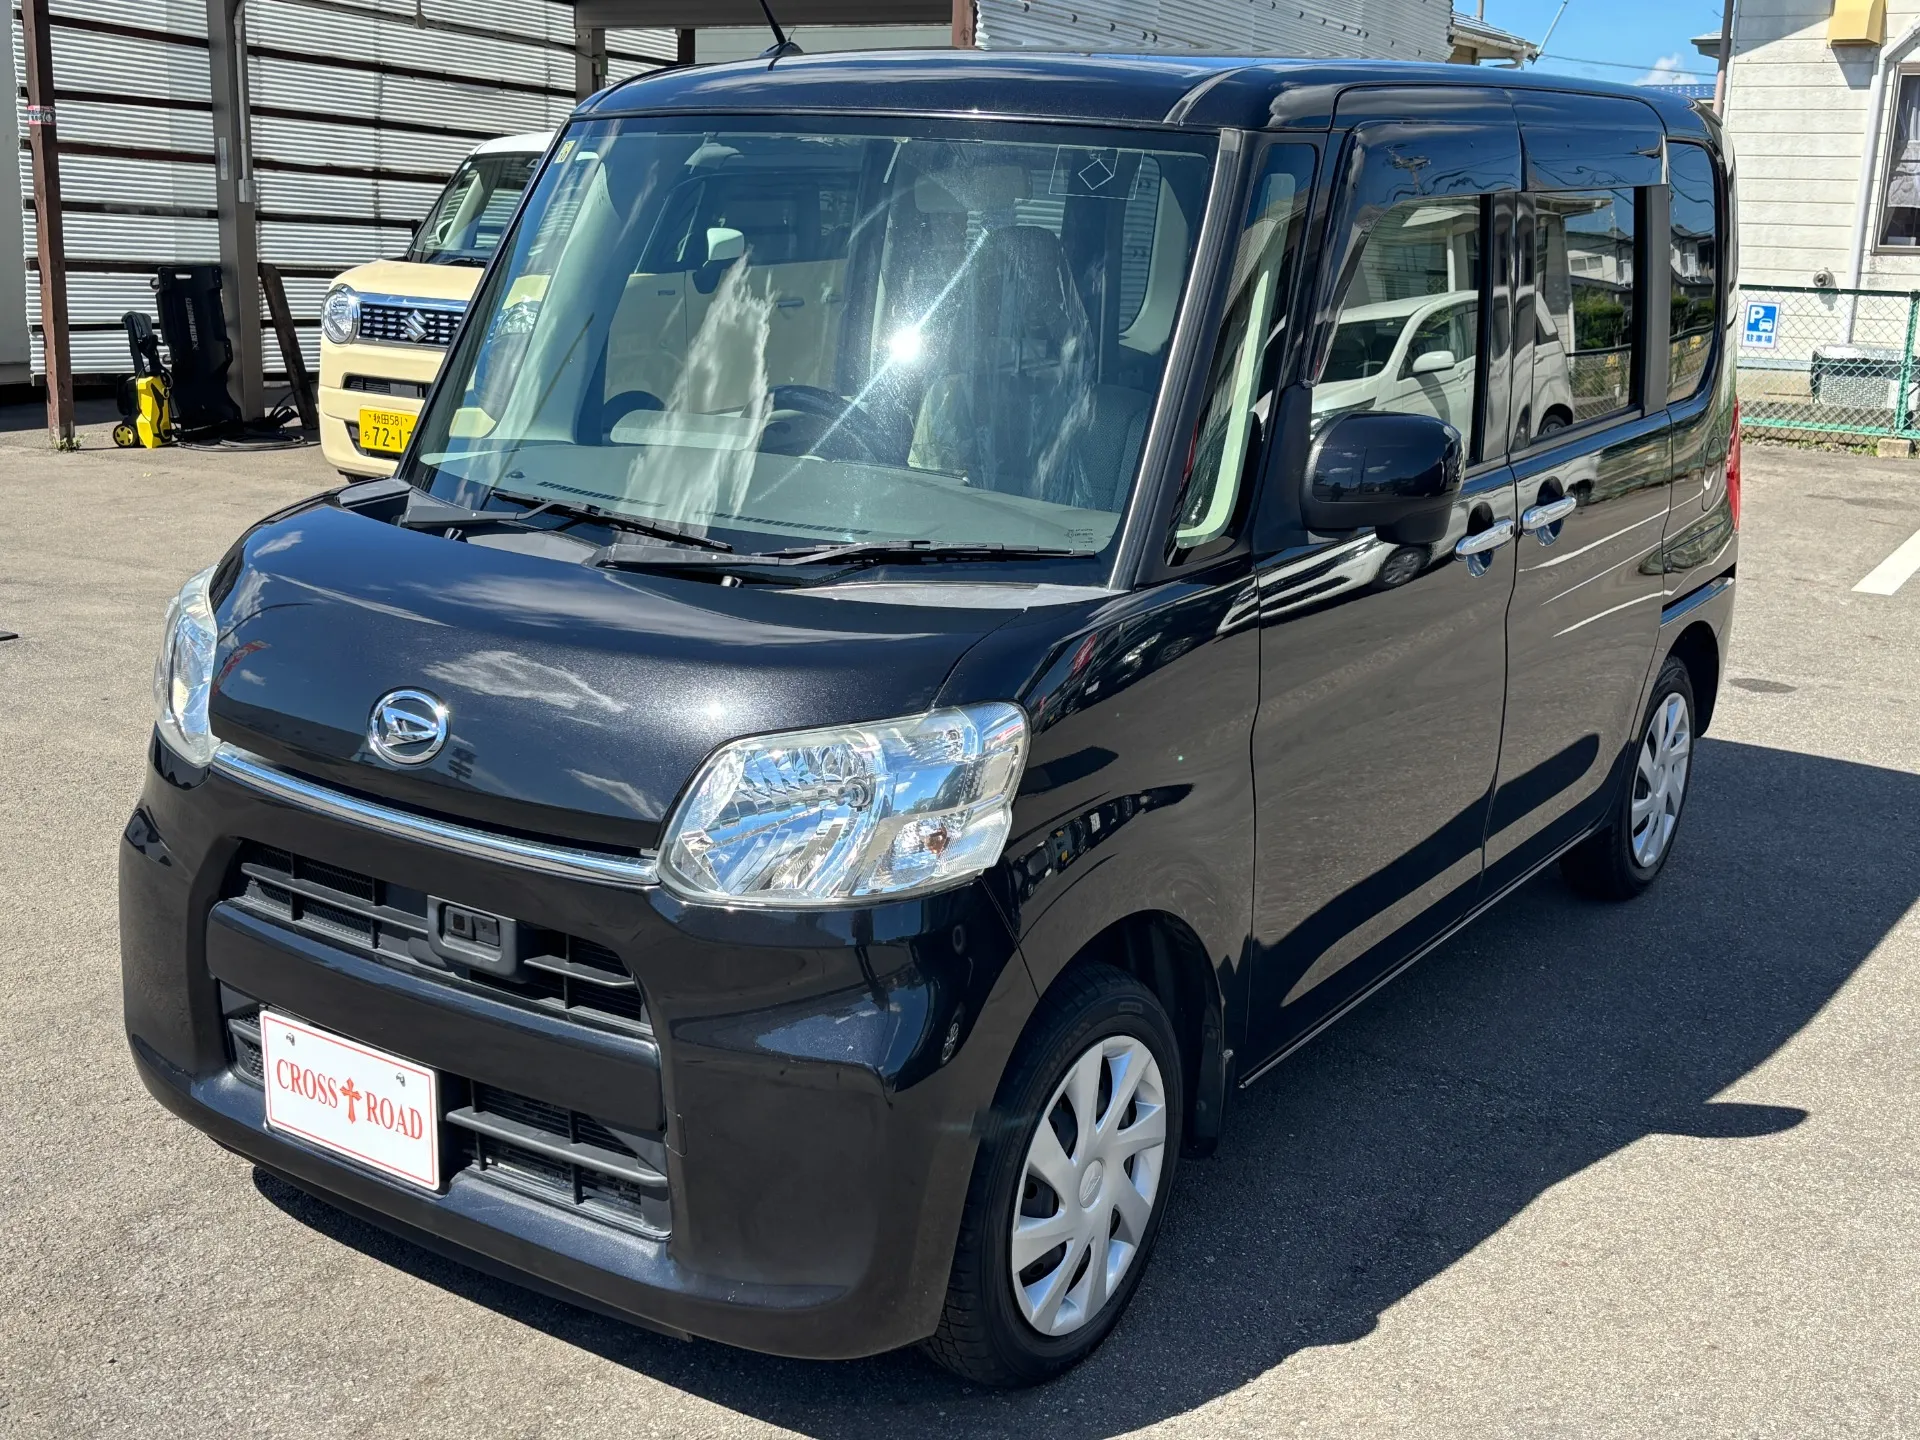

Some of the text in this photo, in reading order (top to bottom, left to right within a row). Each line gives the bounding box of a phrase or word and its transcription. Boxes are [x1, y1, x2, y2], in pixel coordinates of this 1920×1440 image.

[1750, 307, 1765, 324] P
[276, 1058, 423, 1140] CROSS ROAD
